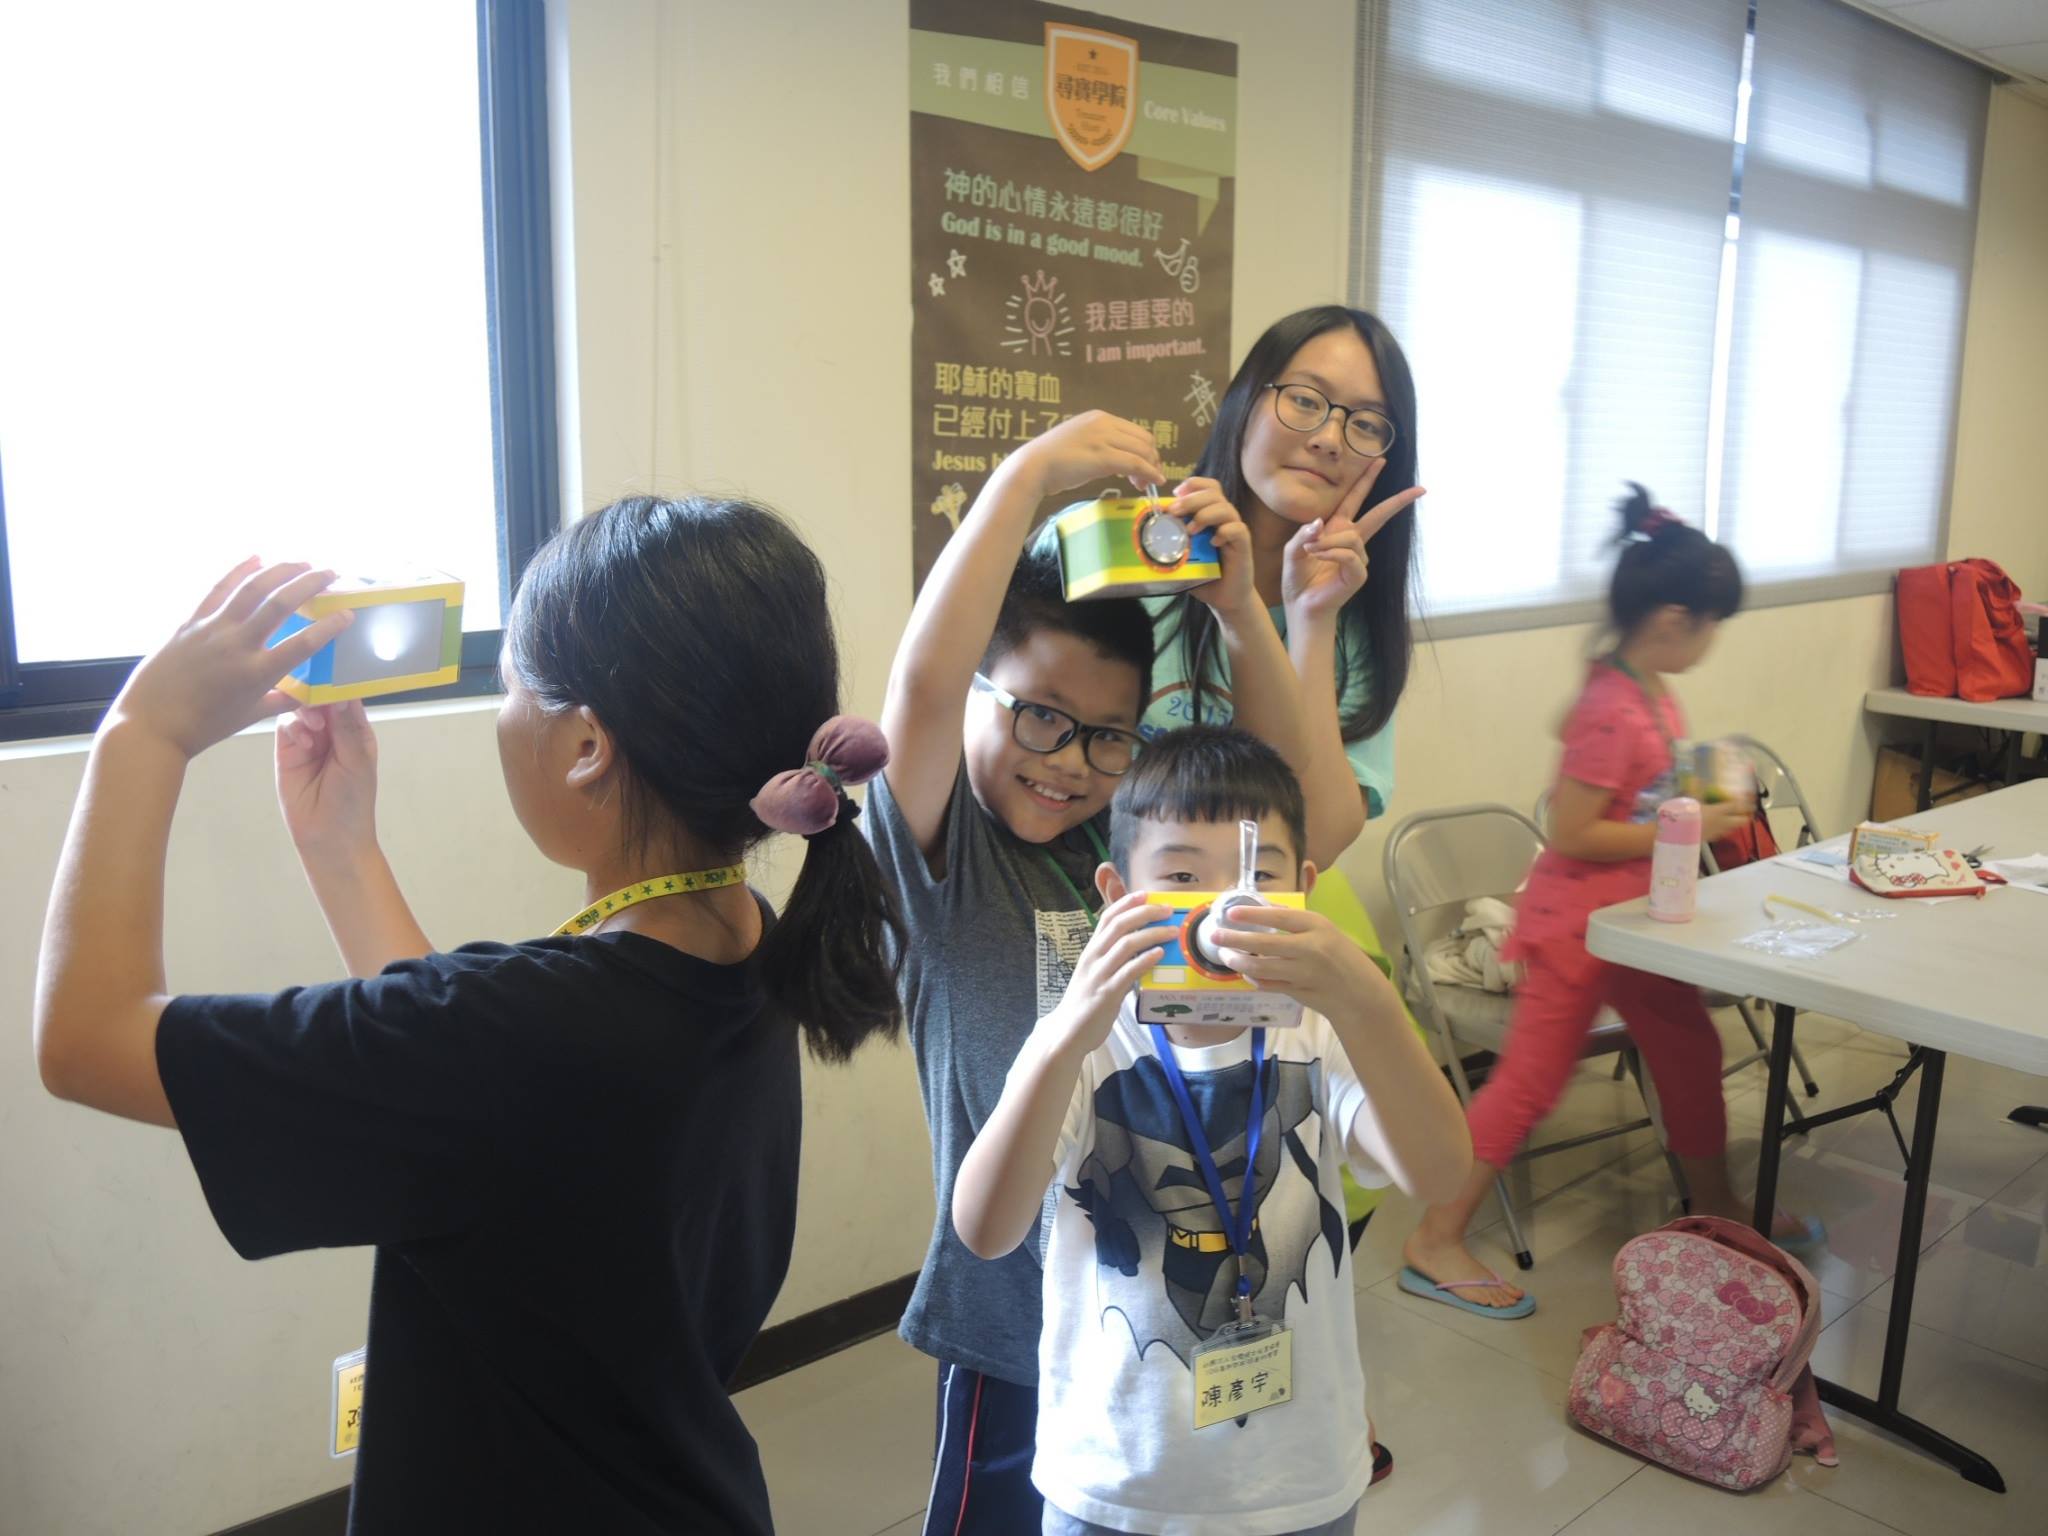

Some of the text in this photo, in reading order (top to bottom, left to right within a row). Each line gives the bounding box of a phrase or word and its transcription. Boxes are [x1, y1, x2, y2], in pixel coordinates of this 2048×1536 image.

[1144, 101, 1227, 132] Core Values
[944, 168, 1163, 241] 神的心情永遠都很好
[941, 211, 1144, 268] God is in a good mood.
[1085, 298, 1195, 332] 我是重要的
[1086, 337, 1206, 363] I am important.
[934, 362, 1061, 403] 耶穌的寶血
[932, 449, 986, 472] Jesus
